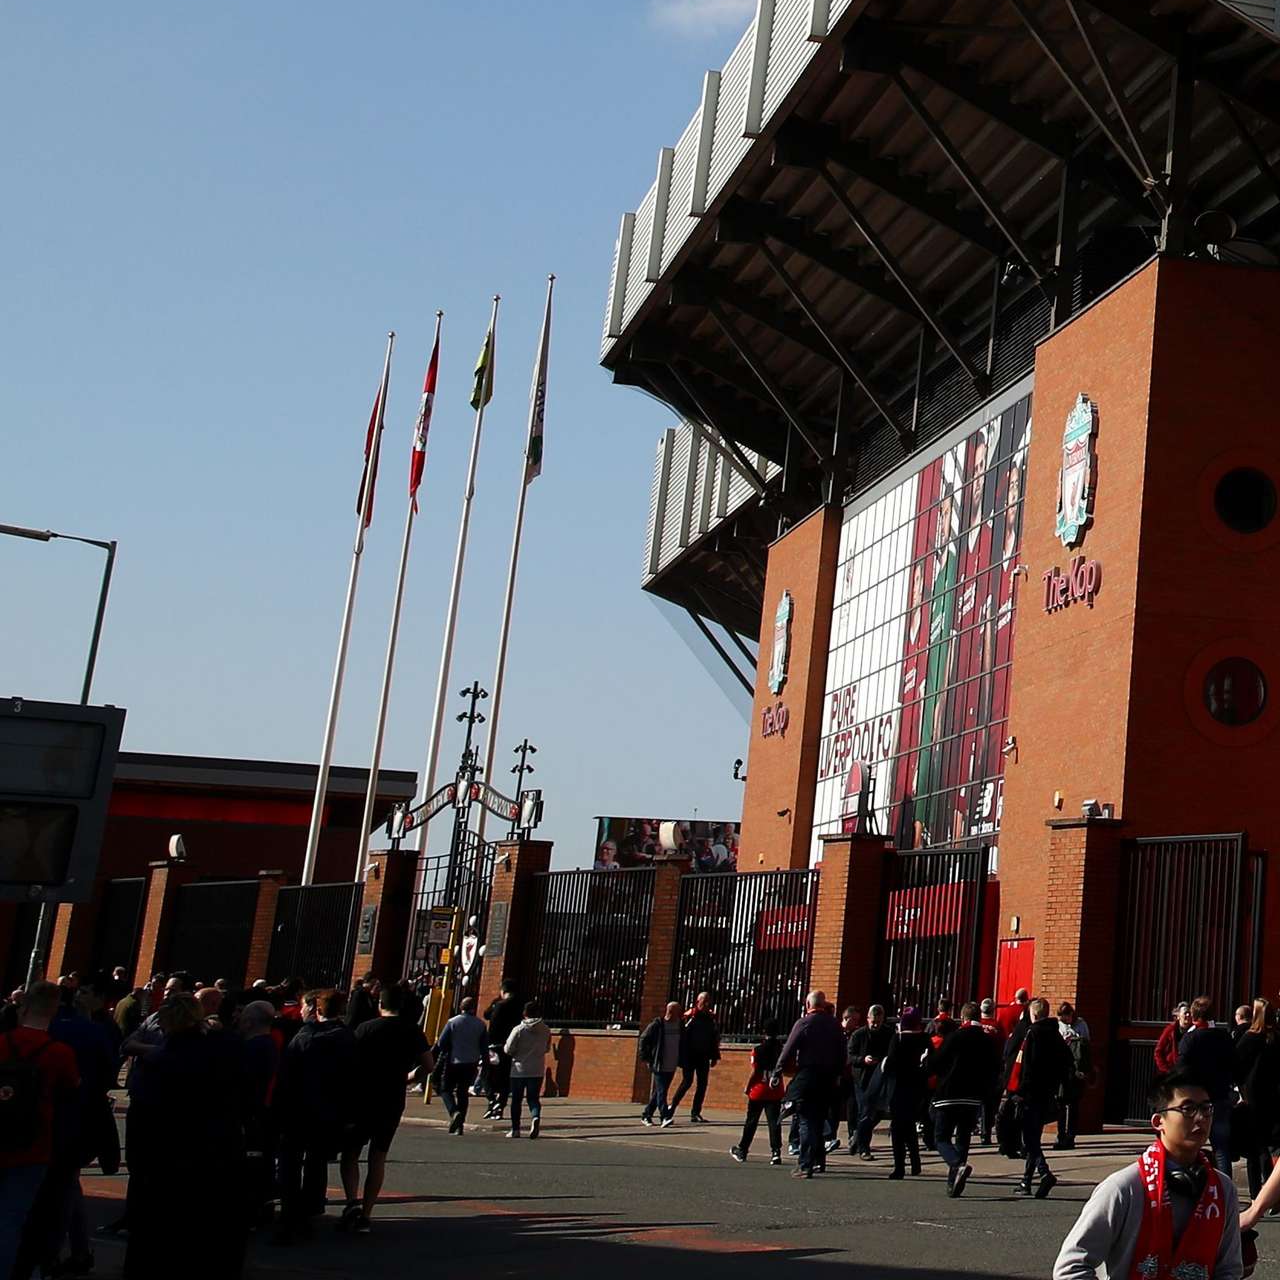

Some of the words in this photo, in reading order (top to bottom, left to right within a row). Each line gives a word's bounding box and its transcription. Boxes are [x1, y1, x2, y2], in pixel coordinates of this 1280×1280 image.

[1042, 569, 1066, 613] The
[1067, 555, 1099, 608] Kop
[13, 701, 22, 713] 3
[830, 684, 857, 732] PURE
[819, 720, 876, 779] LIVERPOOL
[875, 714, 892, 762] FC
